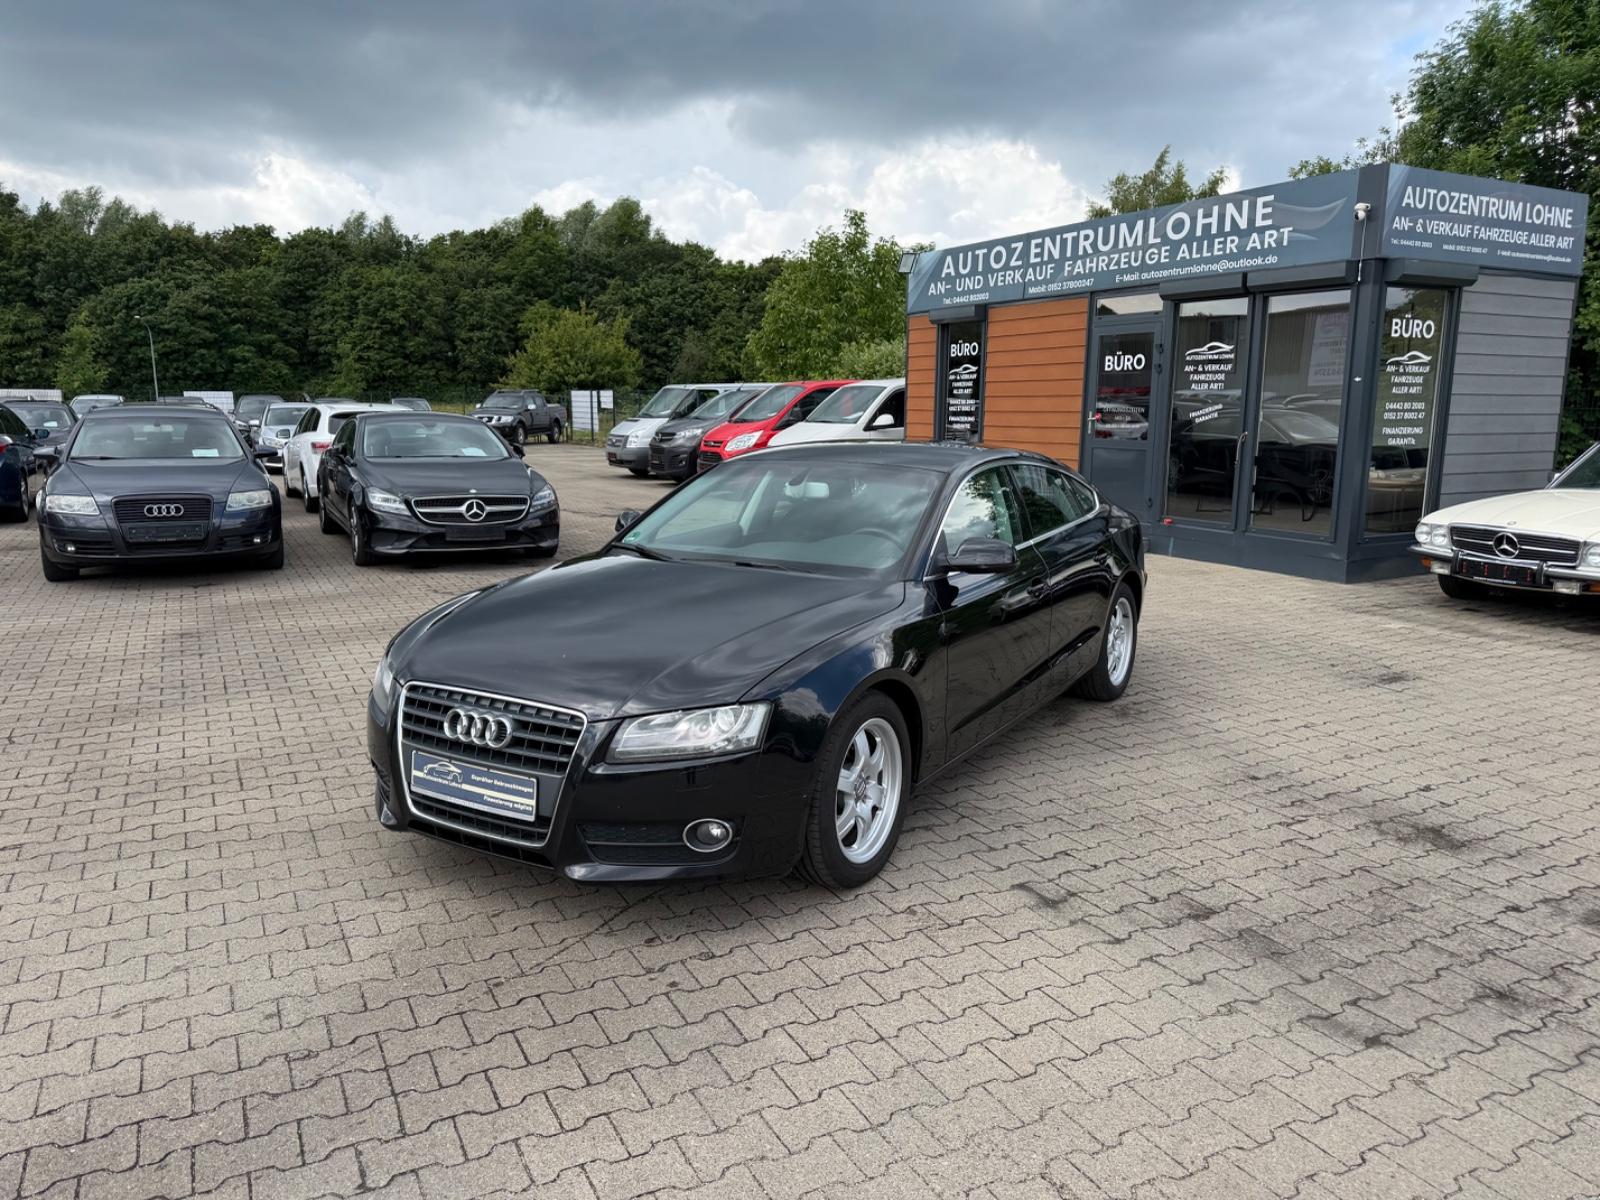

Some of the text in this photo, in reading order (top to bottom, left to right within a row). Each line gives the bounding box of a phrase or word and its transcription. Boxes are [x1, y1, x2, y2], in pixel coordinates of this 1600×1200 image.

[1402, 185, 1574, 228] AUTOZENTRUM LOHNE
[1392, 215, 1574, 249] AN- & VERKAUF FAHRZEUGE ALLER ART
[928, 227, 1294, 296] AN- UND VERKAUF FAHRZEUGE ALLER ART
[1141, 255, 1278, 280] autozentrumlohne@outlook.de
[1390, 314, 1435, 339] BÜRO
[950, 339, 979, 357] BÜRO
[1104, 352, 1146, 372] BÜRO
[1204, 363, 1233, 371] VERKAUF
[1404, 364, 1431, 373] VERKAUF
[1189, 373, 1225, 381] FAHRZEUGE
[1191, 382, 1208, 390] ALLER
[1391, 375, 1424, 384] FAHRZEUGE
[1391, 386, 1408, 394] ALLER
